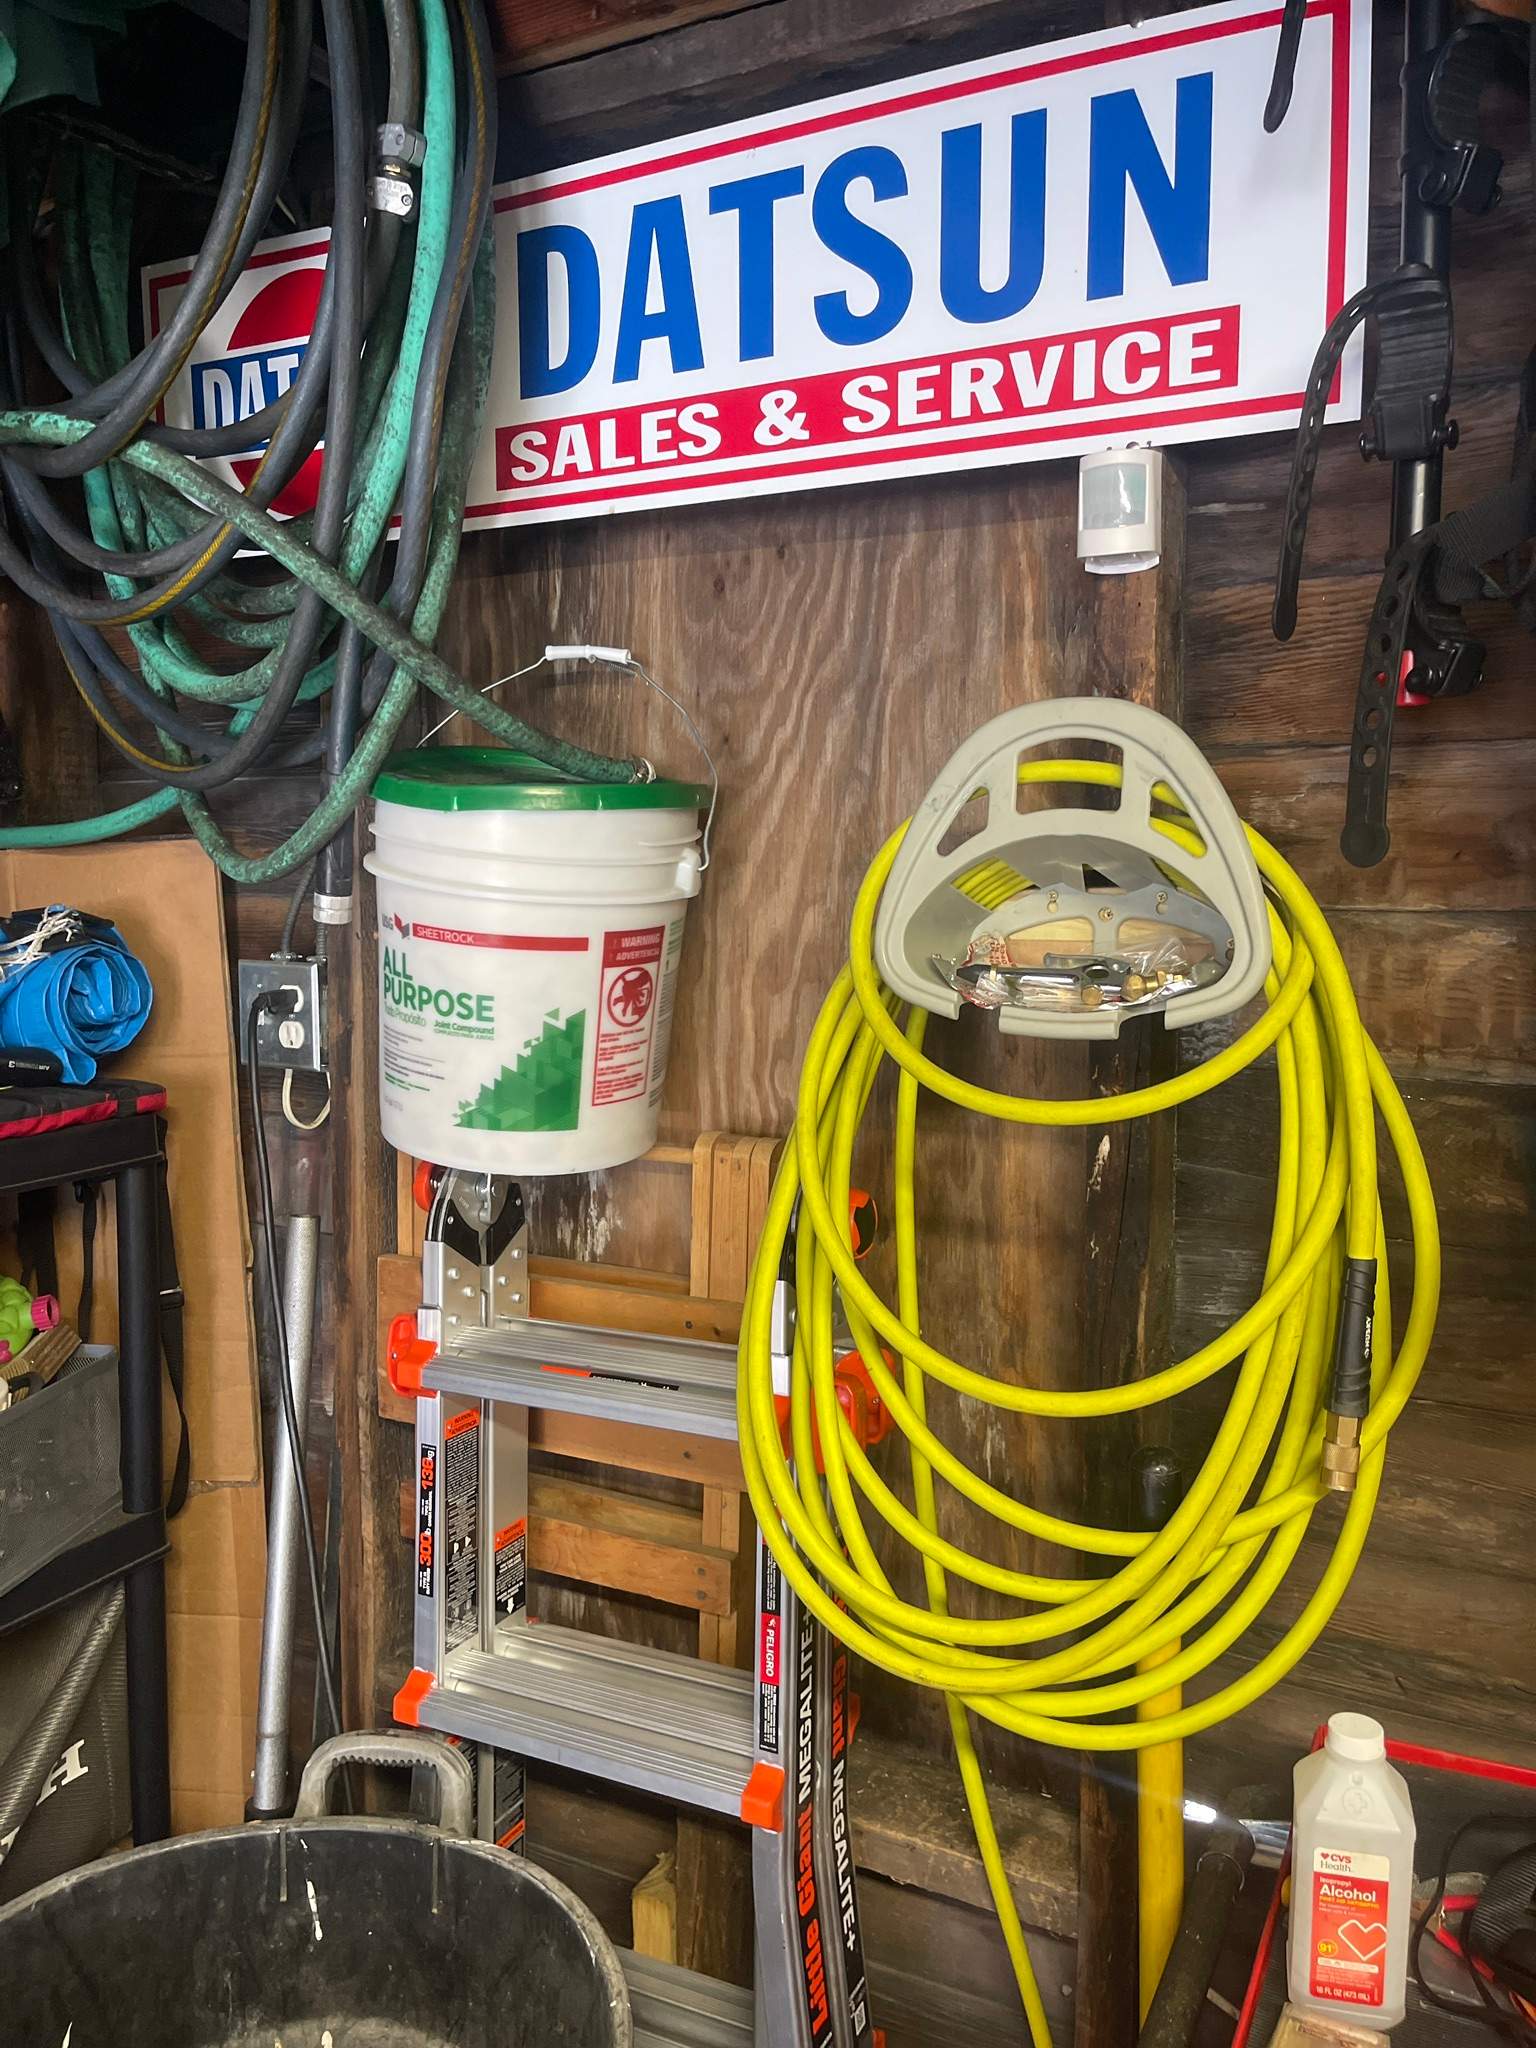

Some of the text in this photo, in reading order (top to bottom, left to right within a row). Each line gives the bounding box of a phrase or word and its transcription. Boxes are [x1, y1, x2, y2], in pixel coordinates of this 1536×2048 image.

[517, 71, 1213, 400] DATSUN
[203, 353, 299, 430] DAT
[509, 319, 1221, 481] SALES & SERVICE
[416, 926, 475, 945] SHEETROCK
[621, 932, 660, 949] WARNING
[383, 946, 413, 981] ALL
[383, 973, 495, 1023] PURPOSE
[451, 1022, 495, 1035] Compound
[765, 1628, 775, 1677] PELIGRO
[797, 1803, 816, 1918] Giant
[831, 1758, 857, 1952] MEGALITE+
[1320, 1861, 1352, 1873] Health
[1330, 1853, 1352, 1864] CVS
[1319, 1875, 1352, 1888] Isopropyl
[1319, 1884, 1376, 1903] Alcohol
[805, 1918, 829, 2036] Little
